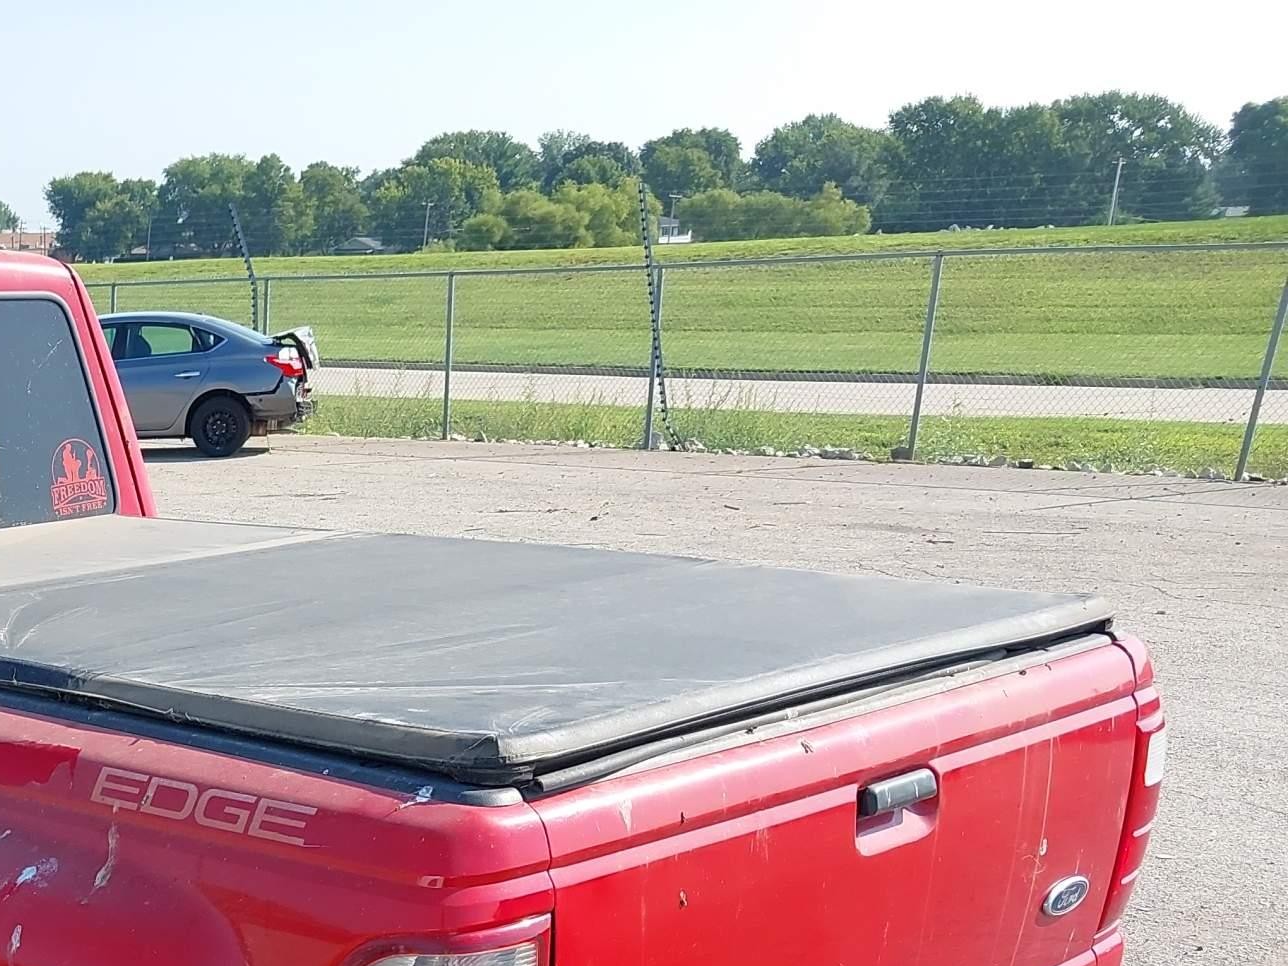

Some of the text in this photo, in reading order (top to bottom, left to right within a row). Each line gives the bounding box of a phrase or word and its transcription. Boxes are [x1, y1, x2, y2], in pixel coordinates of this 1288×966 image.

[52, 480, 106, 504] FREEDOM
[59, 500, 104, 516] ISN'T FREE
[90, 766, 319, 847] EDGE
